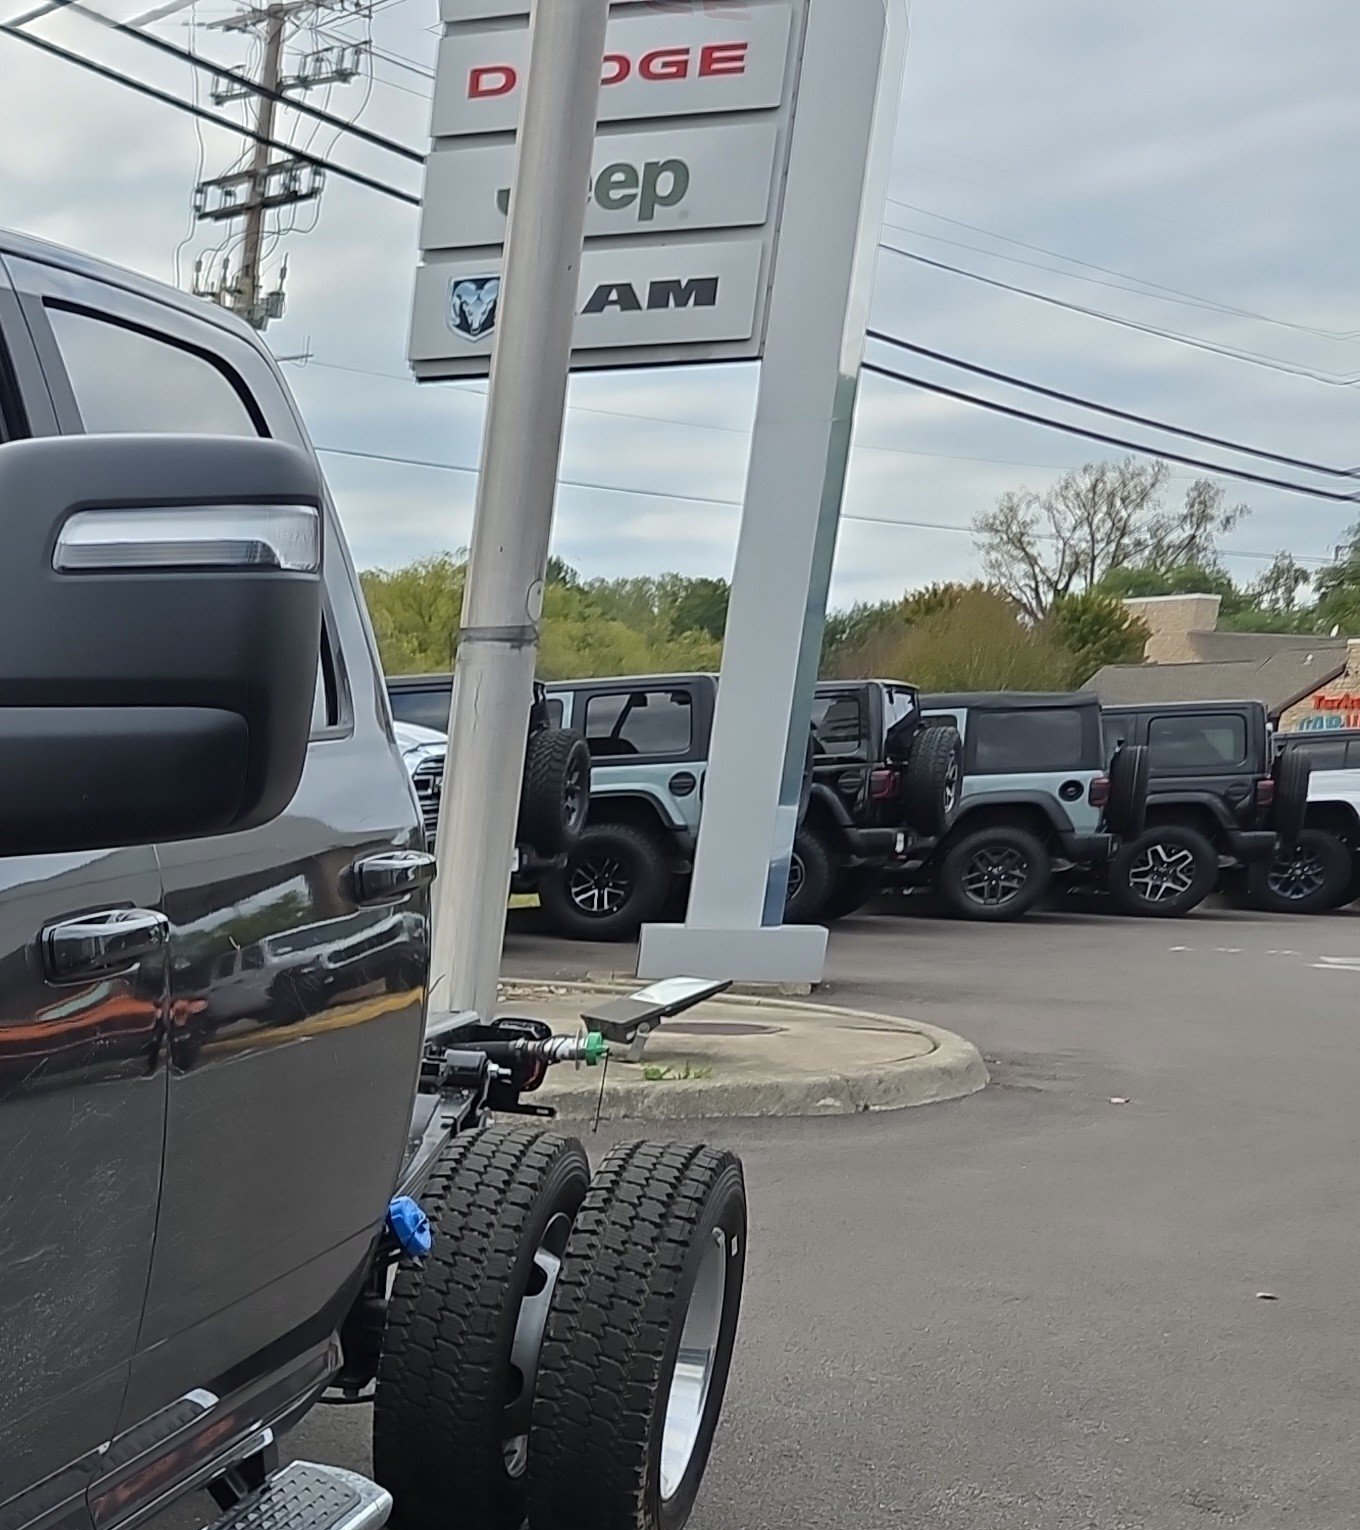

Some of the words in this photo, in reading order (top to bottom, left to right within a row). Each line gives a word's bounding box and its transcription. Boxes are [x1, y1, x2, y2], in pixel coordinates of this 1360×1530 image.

[467, 42, 749, 99] DDGE
[496, 158, 691, 222] ep
[581, 276, 719, 314] AM
